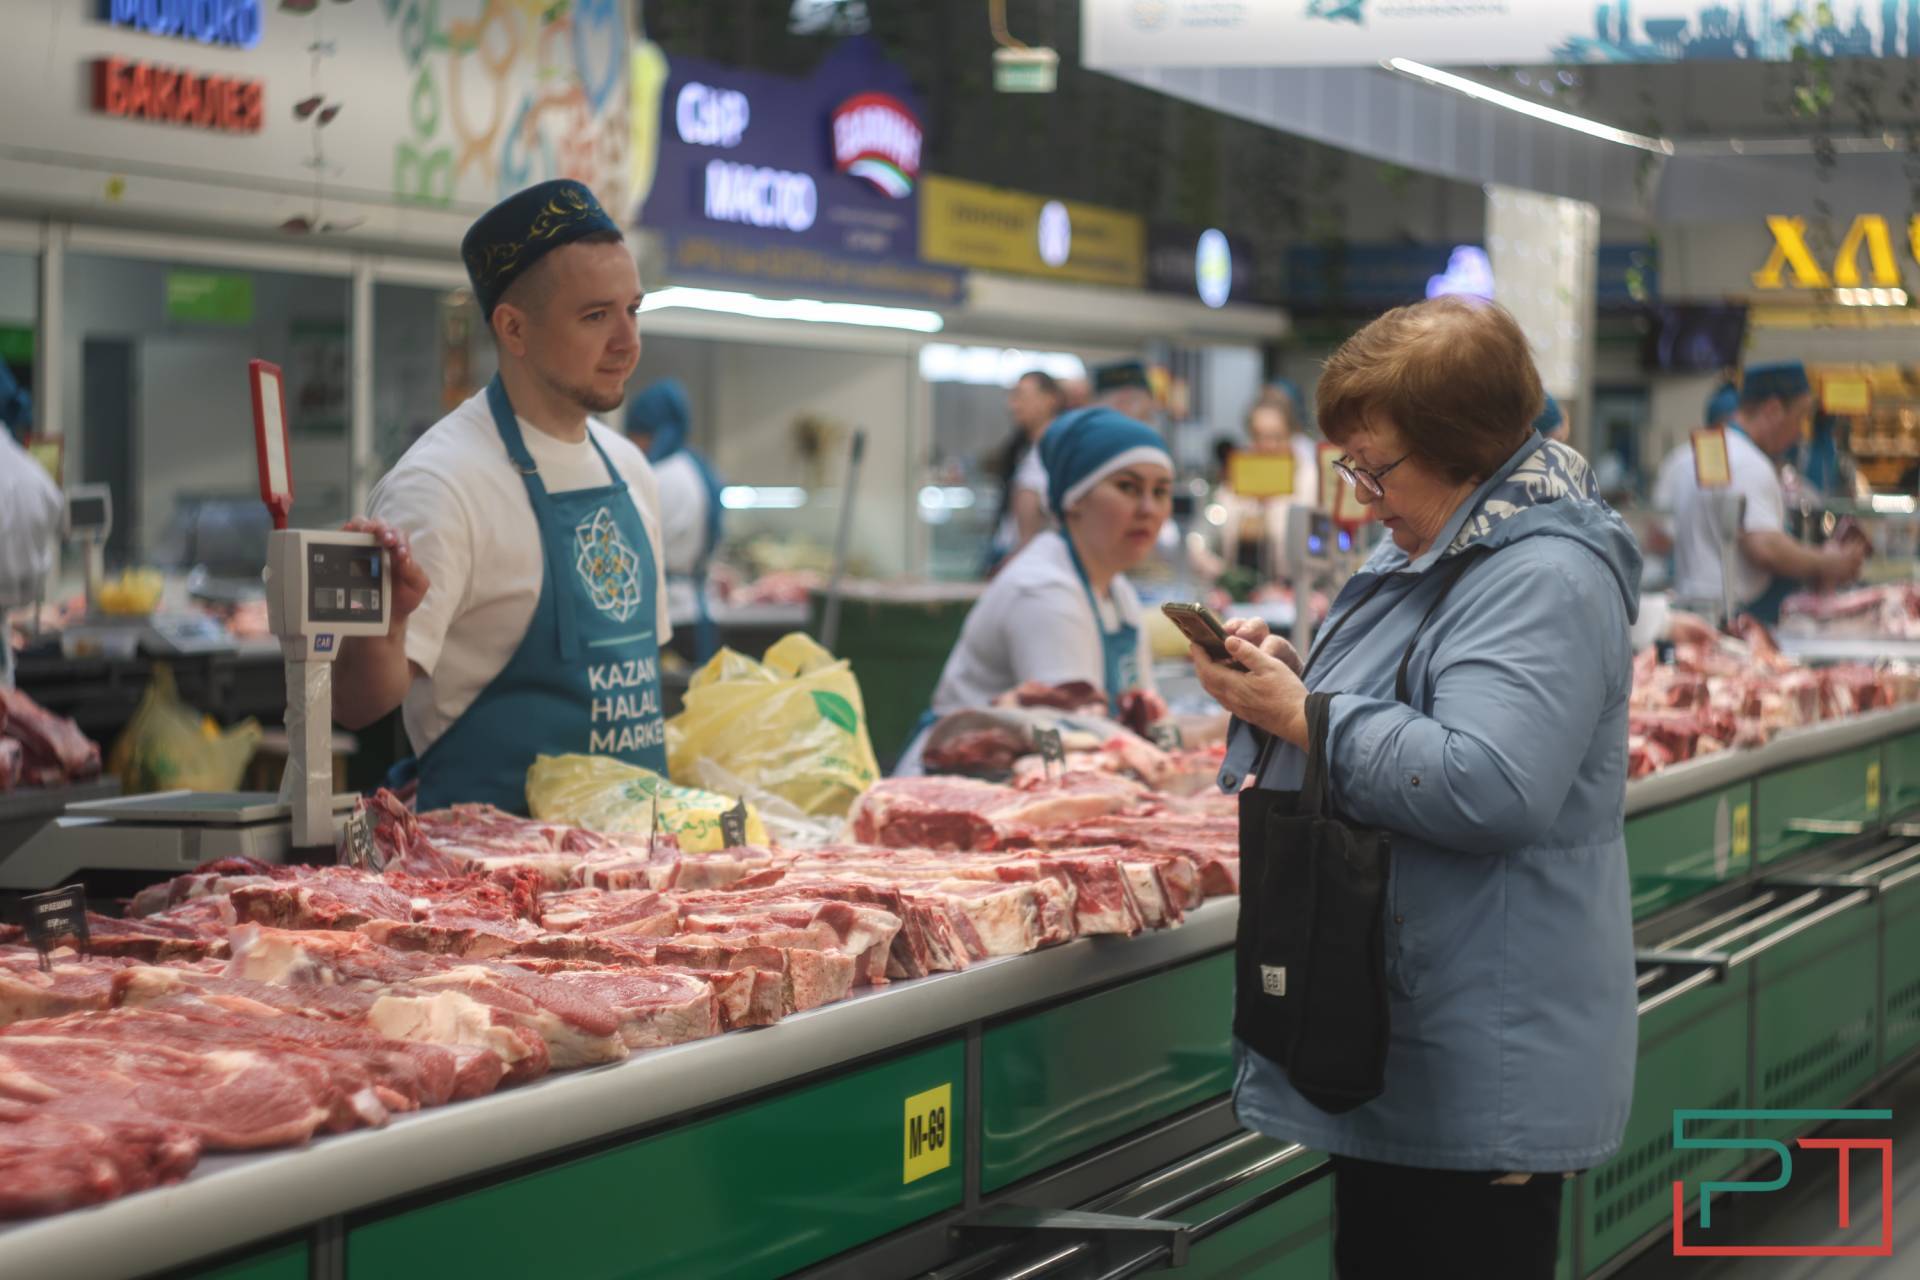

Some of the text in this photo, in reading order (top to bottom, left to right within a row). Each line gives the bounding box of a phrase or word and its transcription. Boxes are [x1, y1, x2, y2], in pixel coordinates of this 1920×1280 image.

[103, 55, 265, 134] БАКАЛЕЯ
[676, 81, 750, 148] СЫР
[704, 159, 818, 232] МАСЛО
[588, 656, 656, 691] KAZAN
[591, 688, 658, 722] HALAL
[589, 717, 664, 753] MARKE
